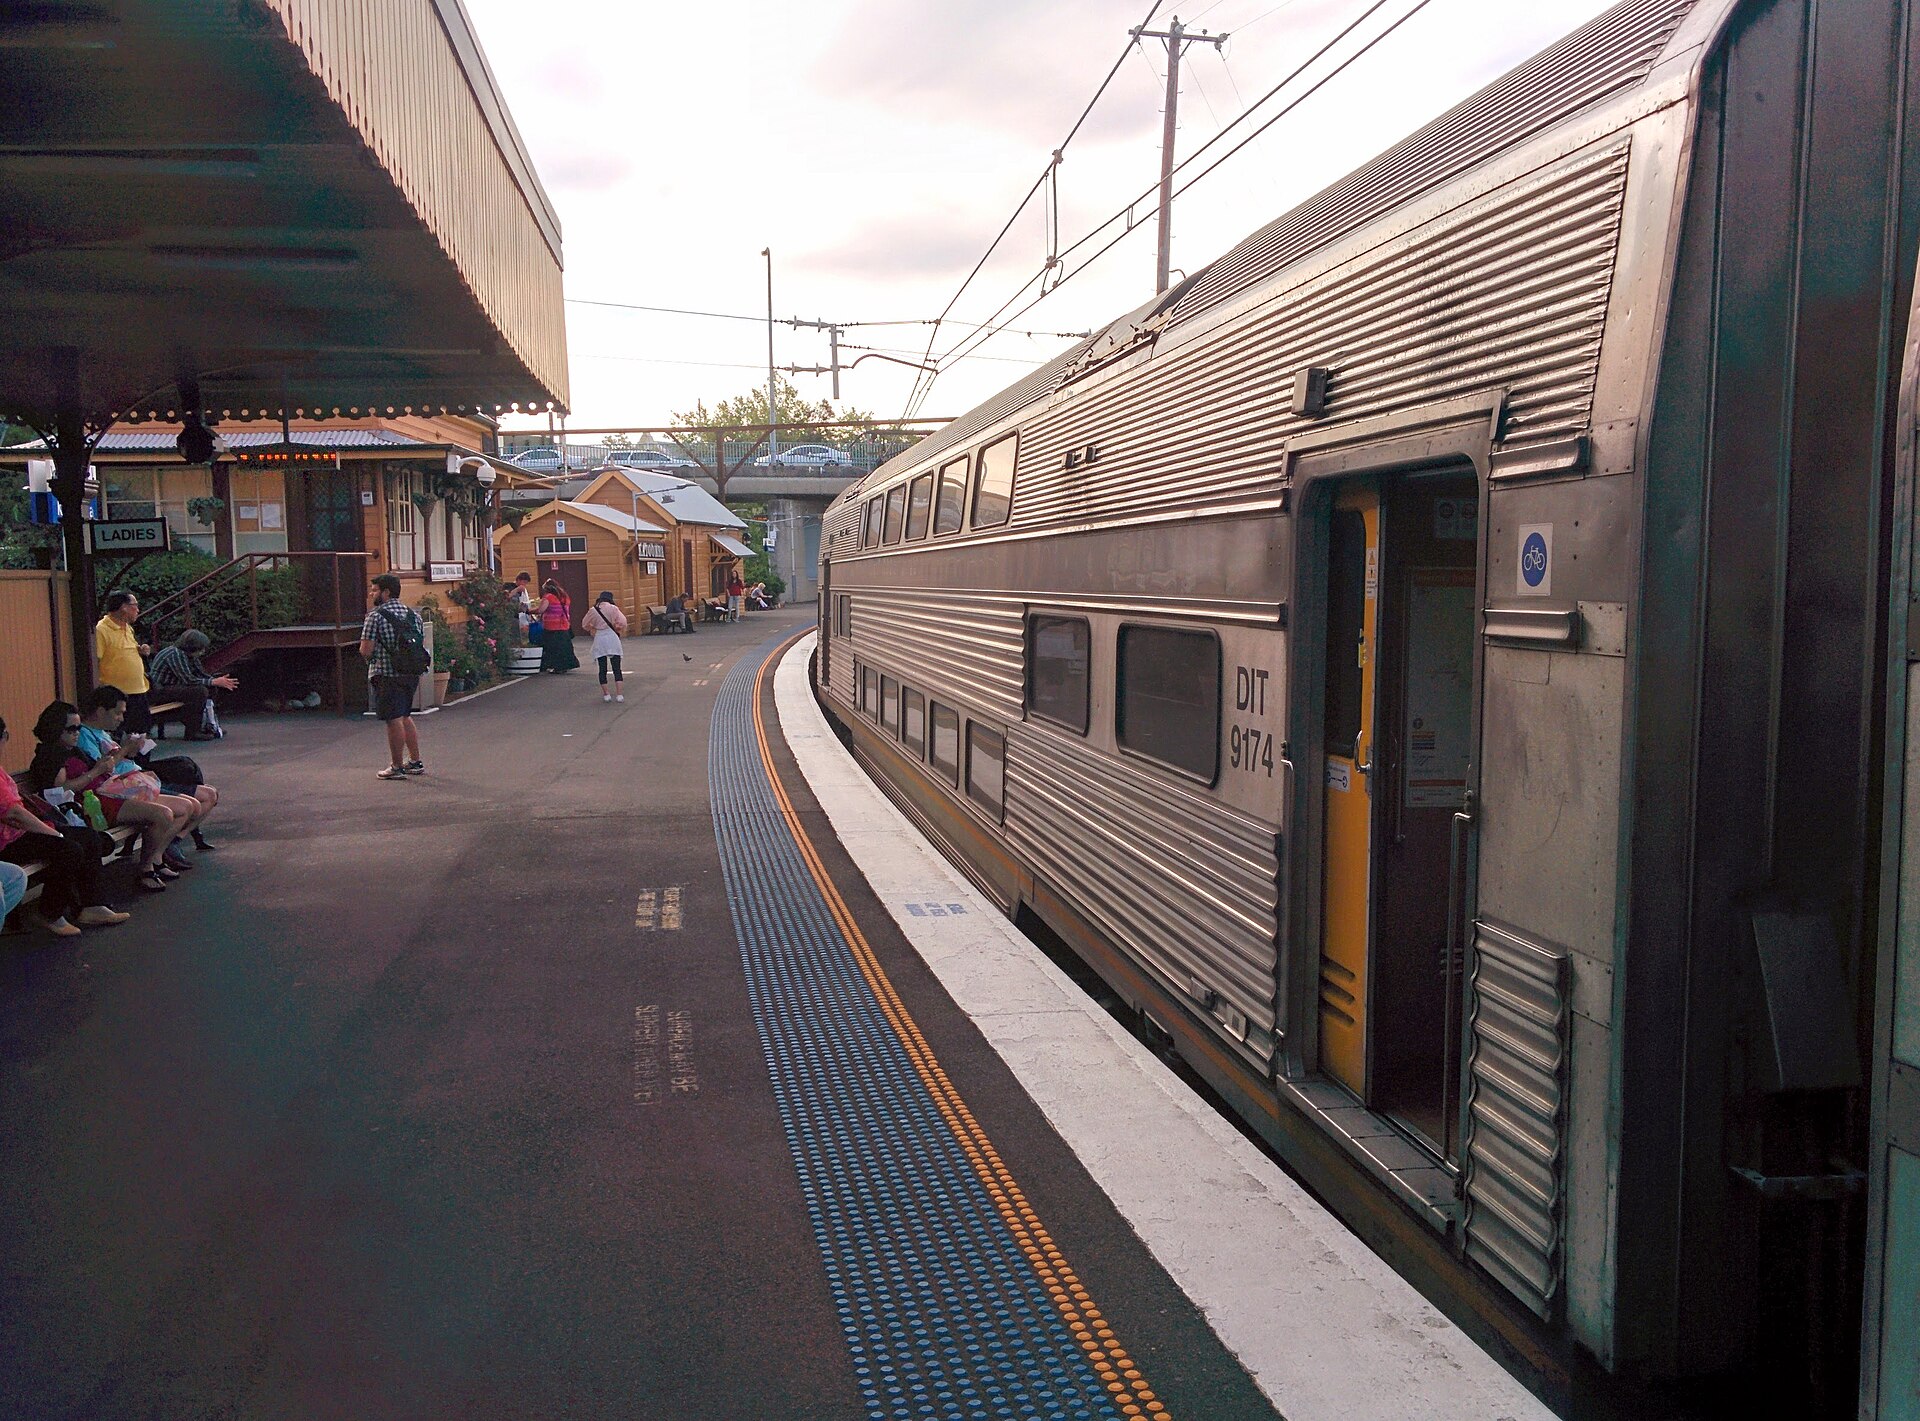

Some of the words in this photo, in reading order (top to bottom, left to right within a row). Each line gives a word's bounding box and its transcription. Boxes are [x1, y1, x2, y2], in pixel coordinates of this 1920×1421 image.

[103, 529, 156, 541] LADIES
[1237, 666, 1269, 715] DIT
[1230, 724, 1274, 778] 9174
